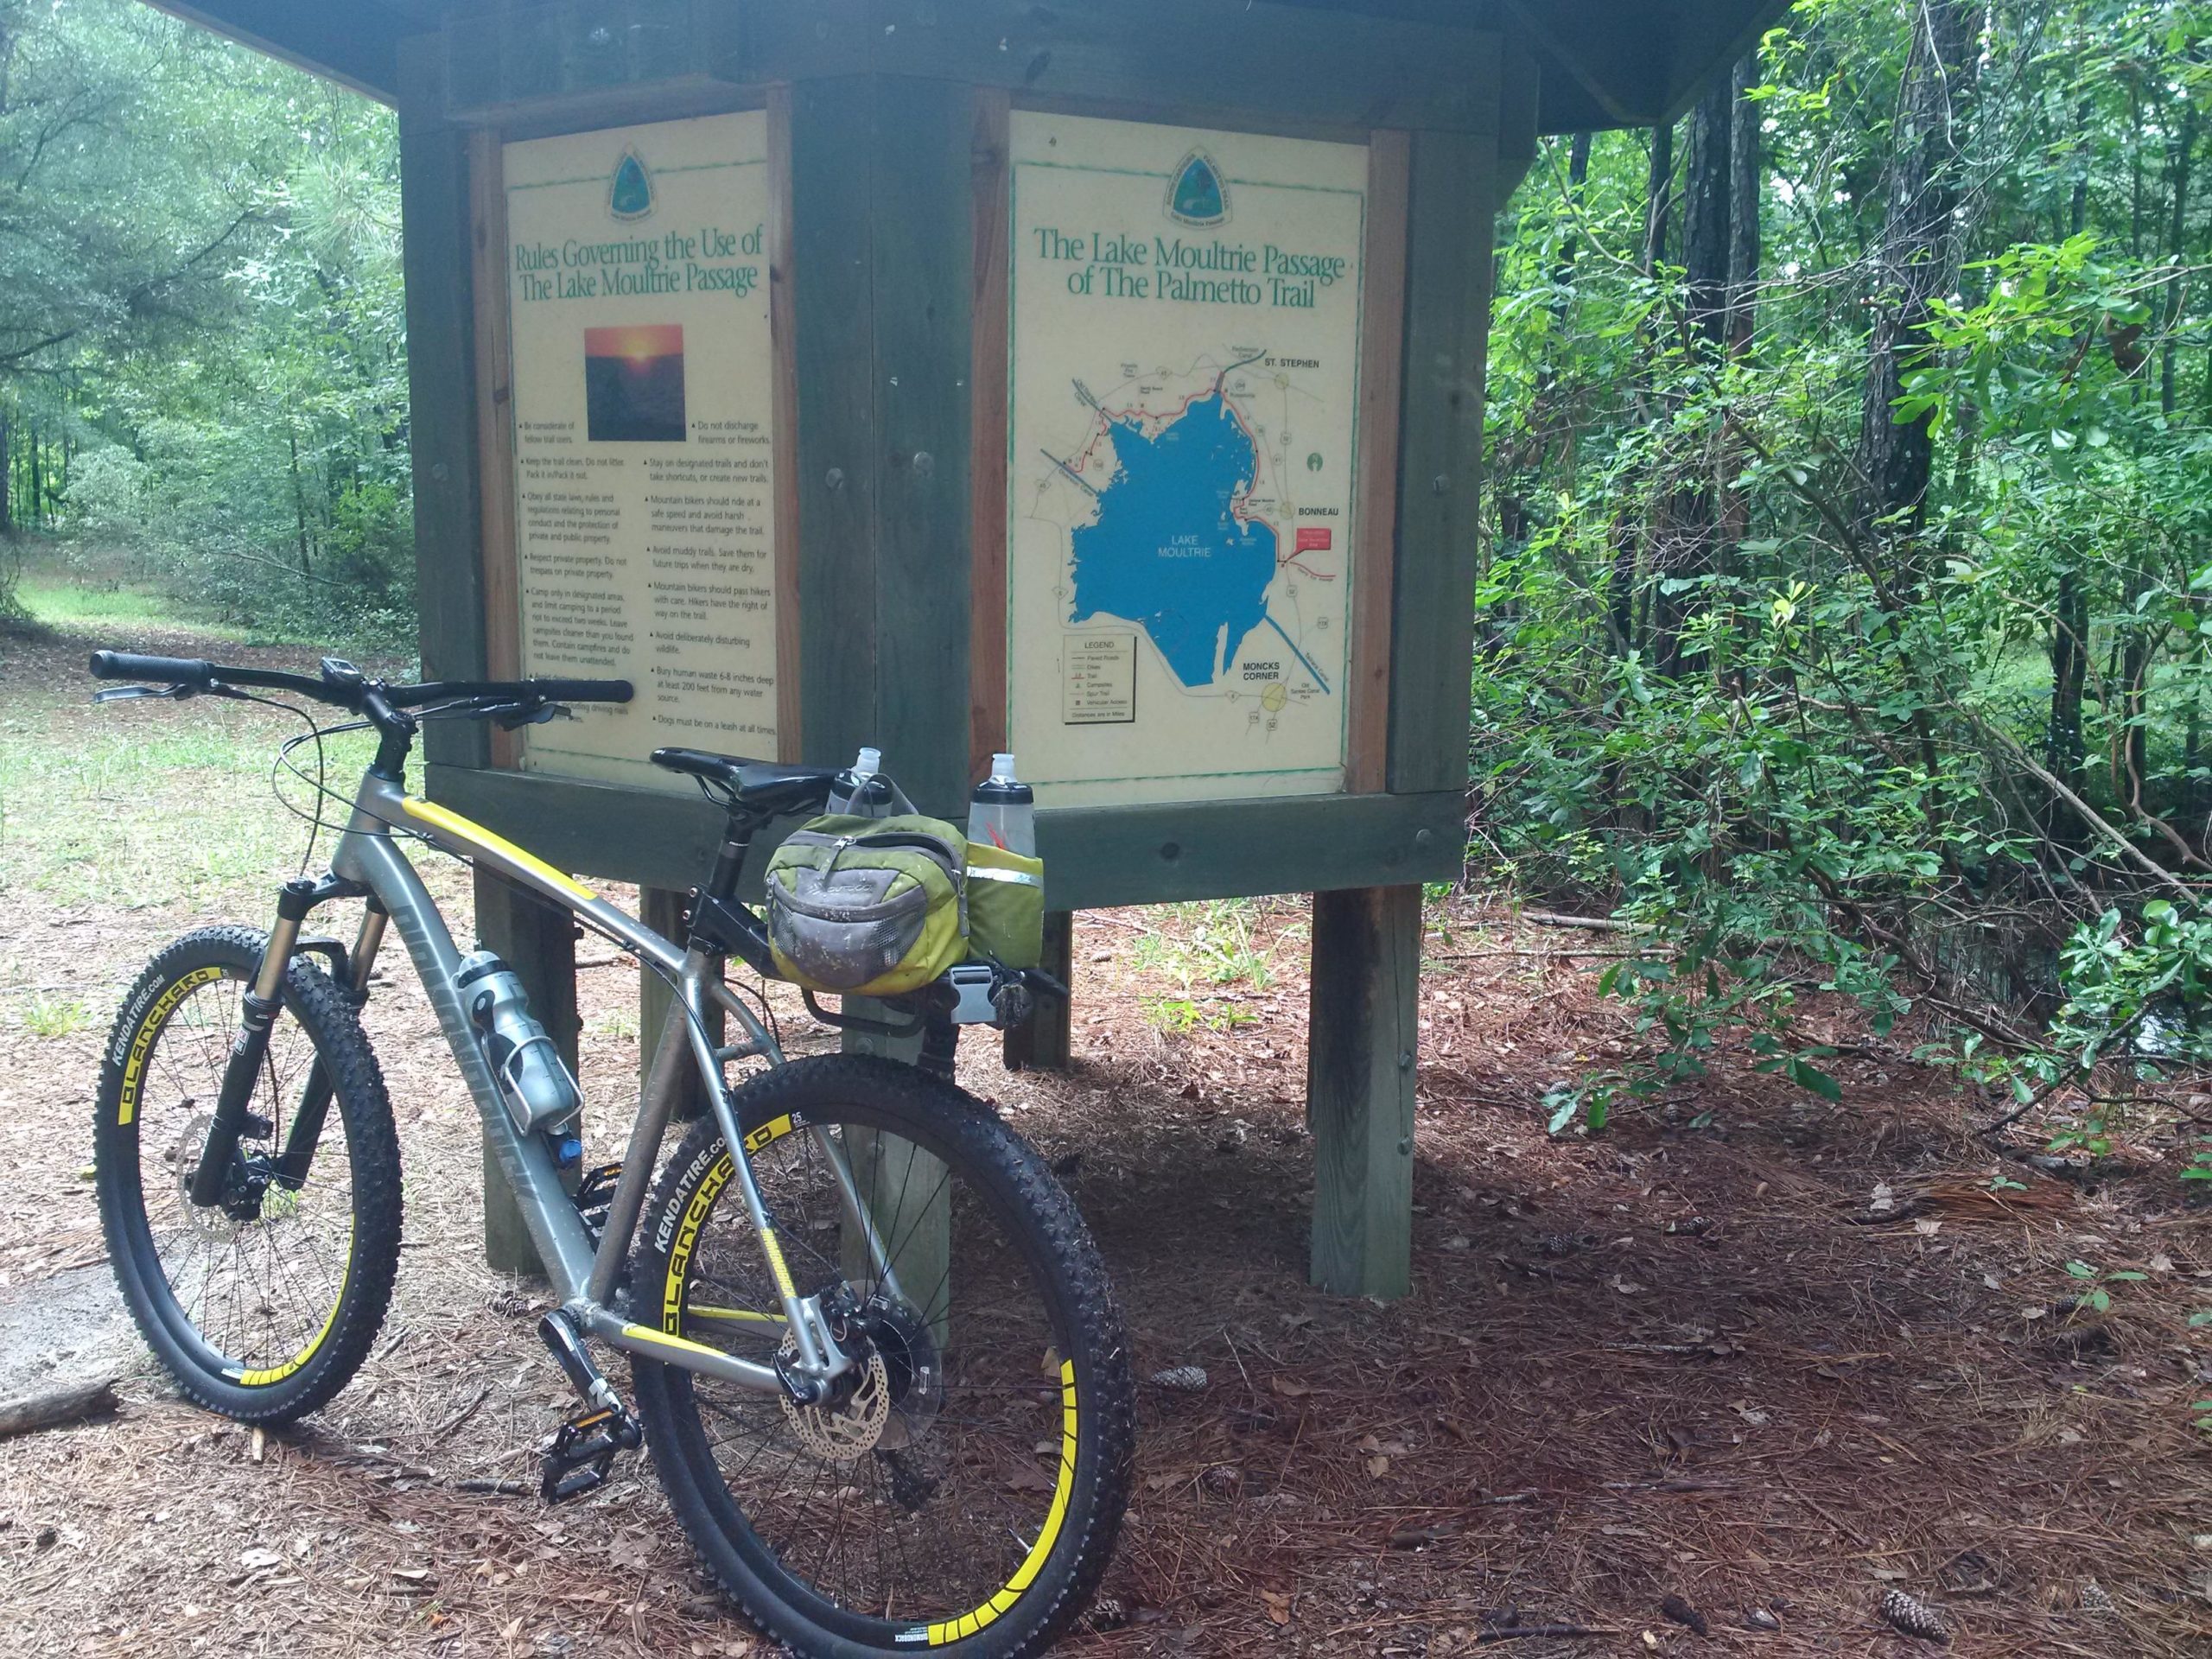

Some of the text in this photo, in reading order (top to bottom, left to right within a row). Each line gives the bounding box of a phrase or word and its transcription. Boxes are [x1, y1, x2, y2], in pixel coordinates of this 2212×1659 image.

[516, 224, 763, 270] Rules Governing the Use of
[1034, 228, 1345, 286] The Lake Moultrie Passage
[520, 263, 757, 301] The Lake Moultrie Passage
[1067, 265, 1315, 308] of The Palmetto Trail
[1265, 358, 1319, 368] ST. STEPHEN
[698, 421, 759, 432] Do not discharge
[698, 435, 726, 443] firearms
[737, 435, 770, 444] fireworks.
[650, 457, 663, 469] Stay
[676, 458, 714, 469] designated
[715, 458, 731, 467] trails
[734, 459, 747, 467] and
[749, 459, 768, 467] don't
[650, 472, 664, 480] take
[665, 472, 697, 483] shortcuts,
[709, 473, 730, 482] create
[749, 474, 768, 483] trails.
[651, 494, 683, 504] Mountain
[684, 495, 704, 505] bikers
[706, 496, 729, 505] should
[731, 497, 745, 505] ride
[747, 497, 754, 505] at
[652, 509, 744, 520] safe speed and avoid harsh
[690, 524, 703, 532] that
[705, 524, 734, 536] damage
[735, 524, 747, 534] the
[748, 525, 763, 535] trail.
[1172, 536, 1198, 545] LAKE
[652, 545, 766, 558] Avoid muddy trails. Save them for
[1158, 547, 1211, 558] MOULTRIE
[652, 559, 672, 569] future
[674, 560, 689, 571] trips
[690, 561, 709, 570] when
[711, 561, 726, 573] they
[741, 563, 753, 575] dry.
[653, 581, 771, 597] Mountain bikers should pass hikers
[654, 594, 669, 604] with
[688, 596, 709, 606] Hikers
[710, 597, 727, 607] have
[728, 599, 740, 607] the
[741, 600, 758, 611] right
[760, 601, 767, 609] of
[655, 610, 668, 620] way
[680, 609, 691, 619] the
[693, 610, 707, 620] trail.
[656, 630, 750, 648] Avoid deliberately disturbing
[656, 644, 680, 654] wildlife.
[1243, 662, 1280, 671] MONCKS
[657, 665, 774, 687] Bury human waste 6-8 inches deep
[1243, 672, 1279, 681] CORNER
[658, 679, 763, 697] at least 200 feet from any water
[658, 714, 675, 726] Dogs
[676, 717, 692, 726] must
[694, 717, 702, 727] be
[720, 720, 737, 730] leash
[739, 722, 746, 731] at
[757, 724, 777, 734] times.
[112, 975, 165, 1066] KENDATIRE.COM
[123, 969, 209, 1104] BLANCHARD
[792, 1111, 802, 1123] 25
[654, 1137, 725, 1253] KENDATIRE.CO
